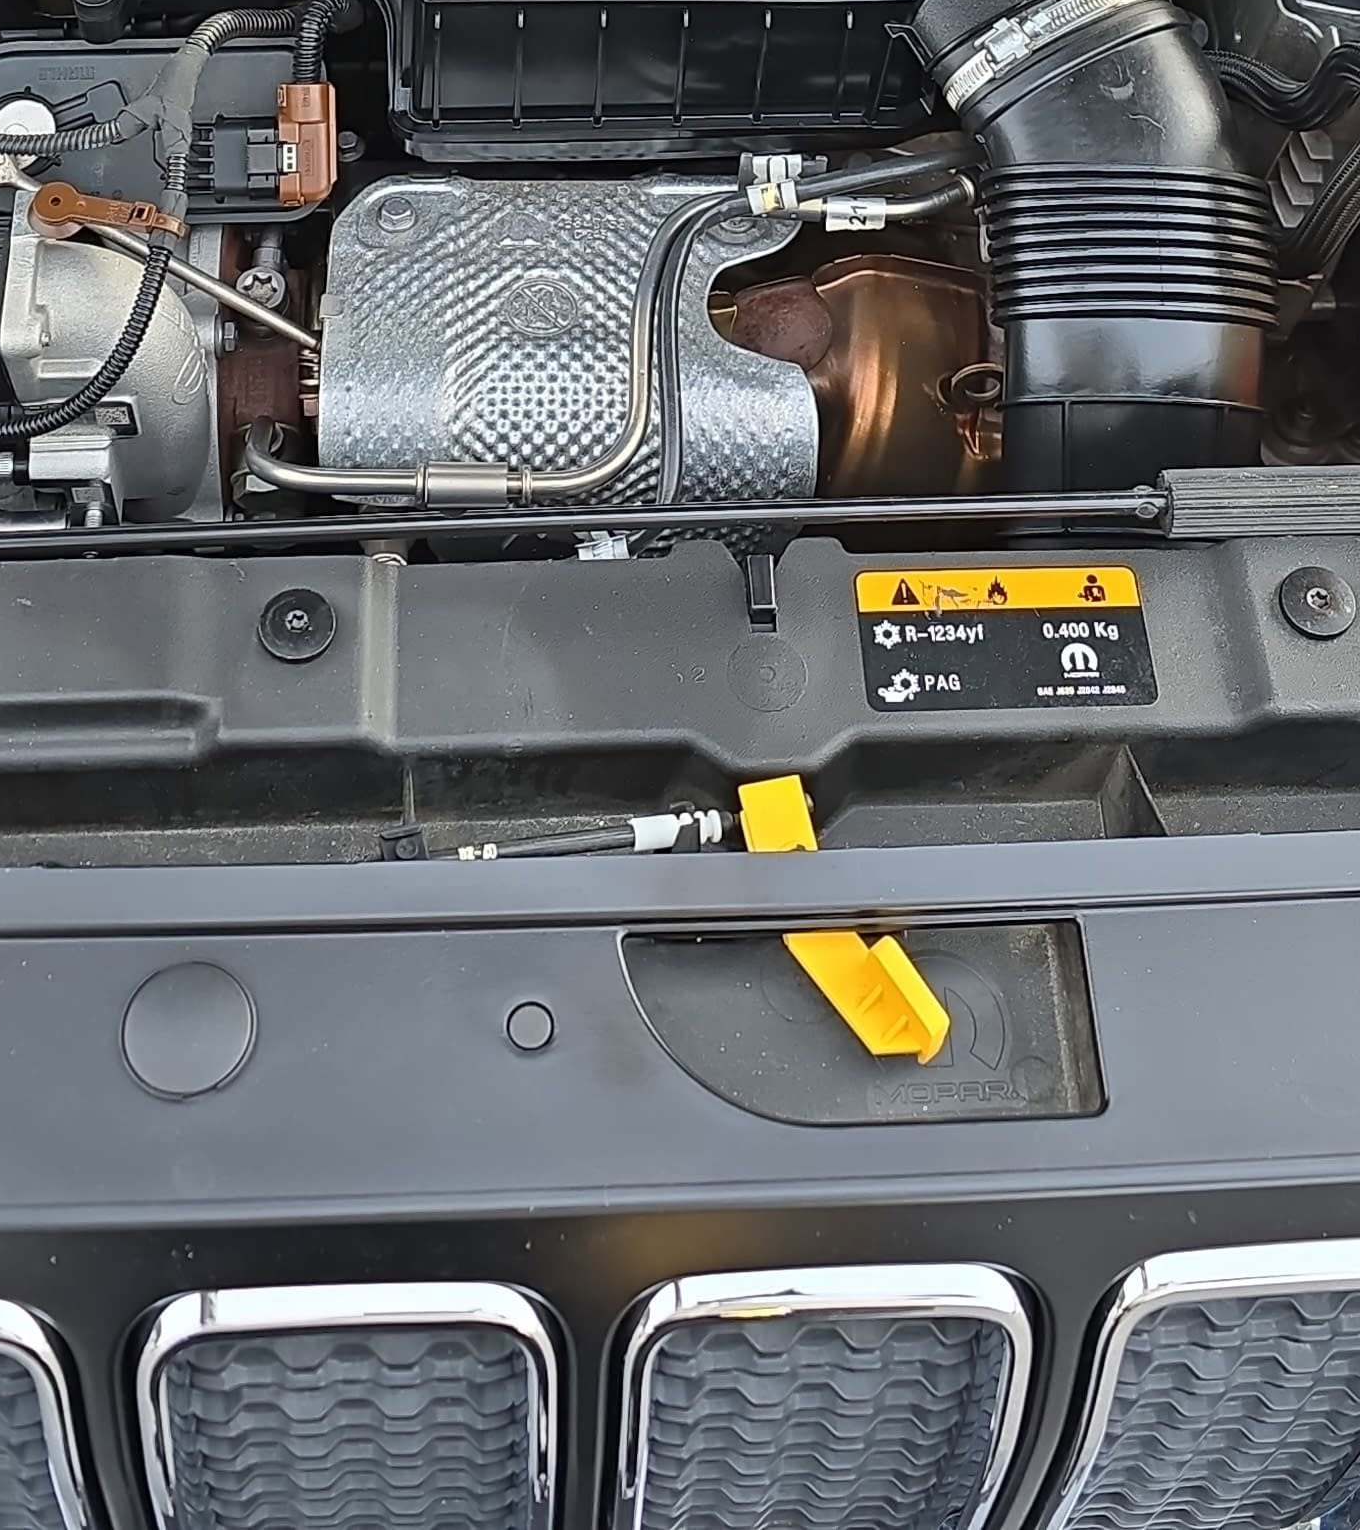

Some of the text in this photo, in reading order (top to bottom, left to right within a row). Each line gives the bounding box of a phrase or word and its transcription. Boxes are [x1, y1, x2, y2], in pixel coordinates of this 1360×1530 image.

[905, 622, 1119, 643] R-1234yf 0.400 Kg
[924, 674, 961, 692] PAG
[875, 1081, 1012, 1105] MOPAR
